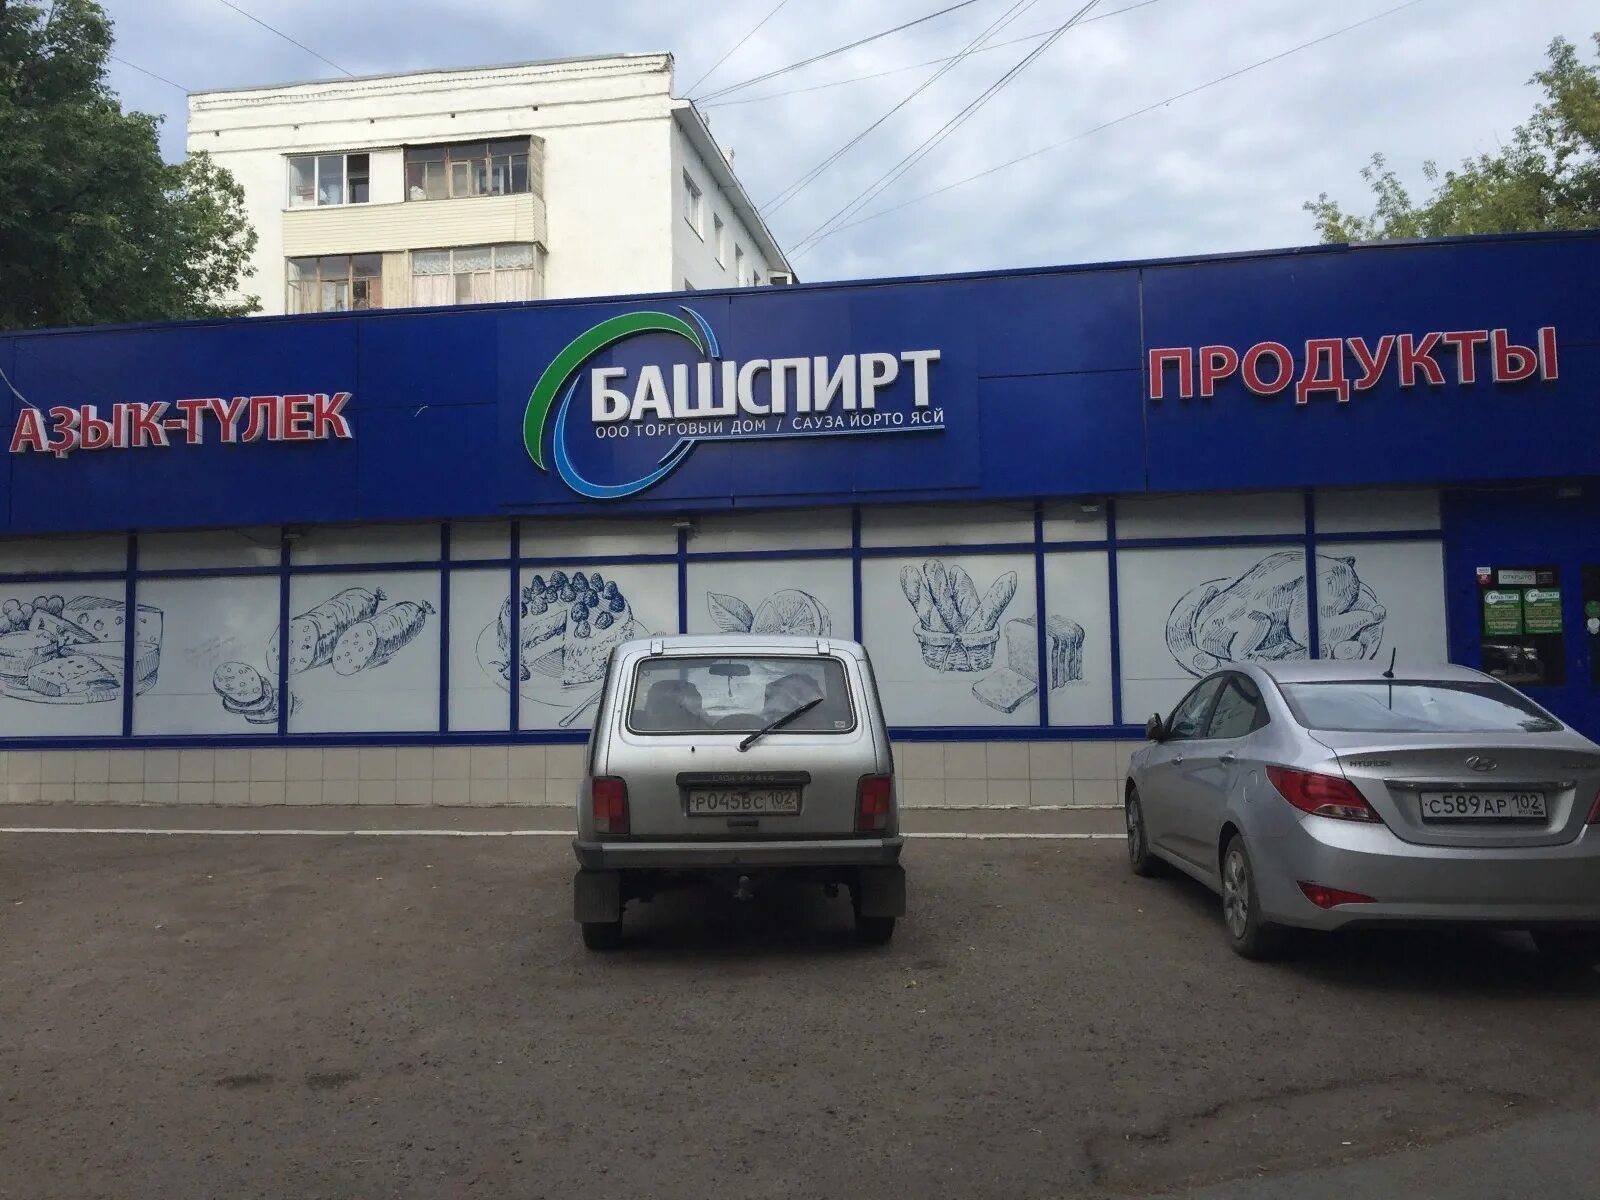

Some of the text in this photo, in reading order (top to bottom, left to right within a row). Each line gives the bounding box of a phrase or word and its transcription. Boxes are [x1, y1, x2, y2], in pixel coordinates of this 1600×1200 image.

[591, 349, 941, 422] БАШСПИРТ
[1149, 326, 1560, 405] ПРОДУКТЫ
[596, 425, 630, 439] ООО
[635, 418, 724, 437] ТОРГОВЫЙ
[730, 419, 767, 435] ДОМ
[792, 415, 845, 430] САУЗА
[850, 411, 904, 427] ЙОРТО
[910, 407, 944, 424] ЯСЙ
[1429, 794, 1540, 814] С589АР 102
